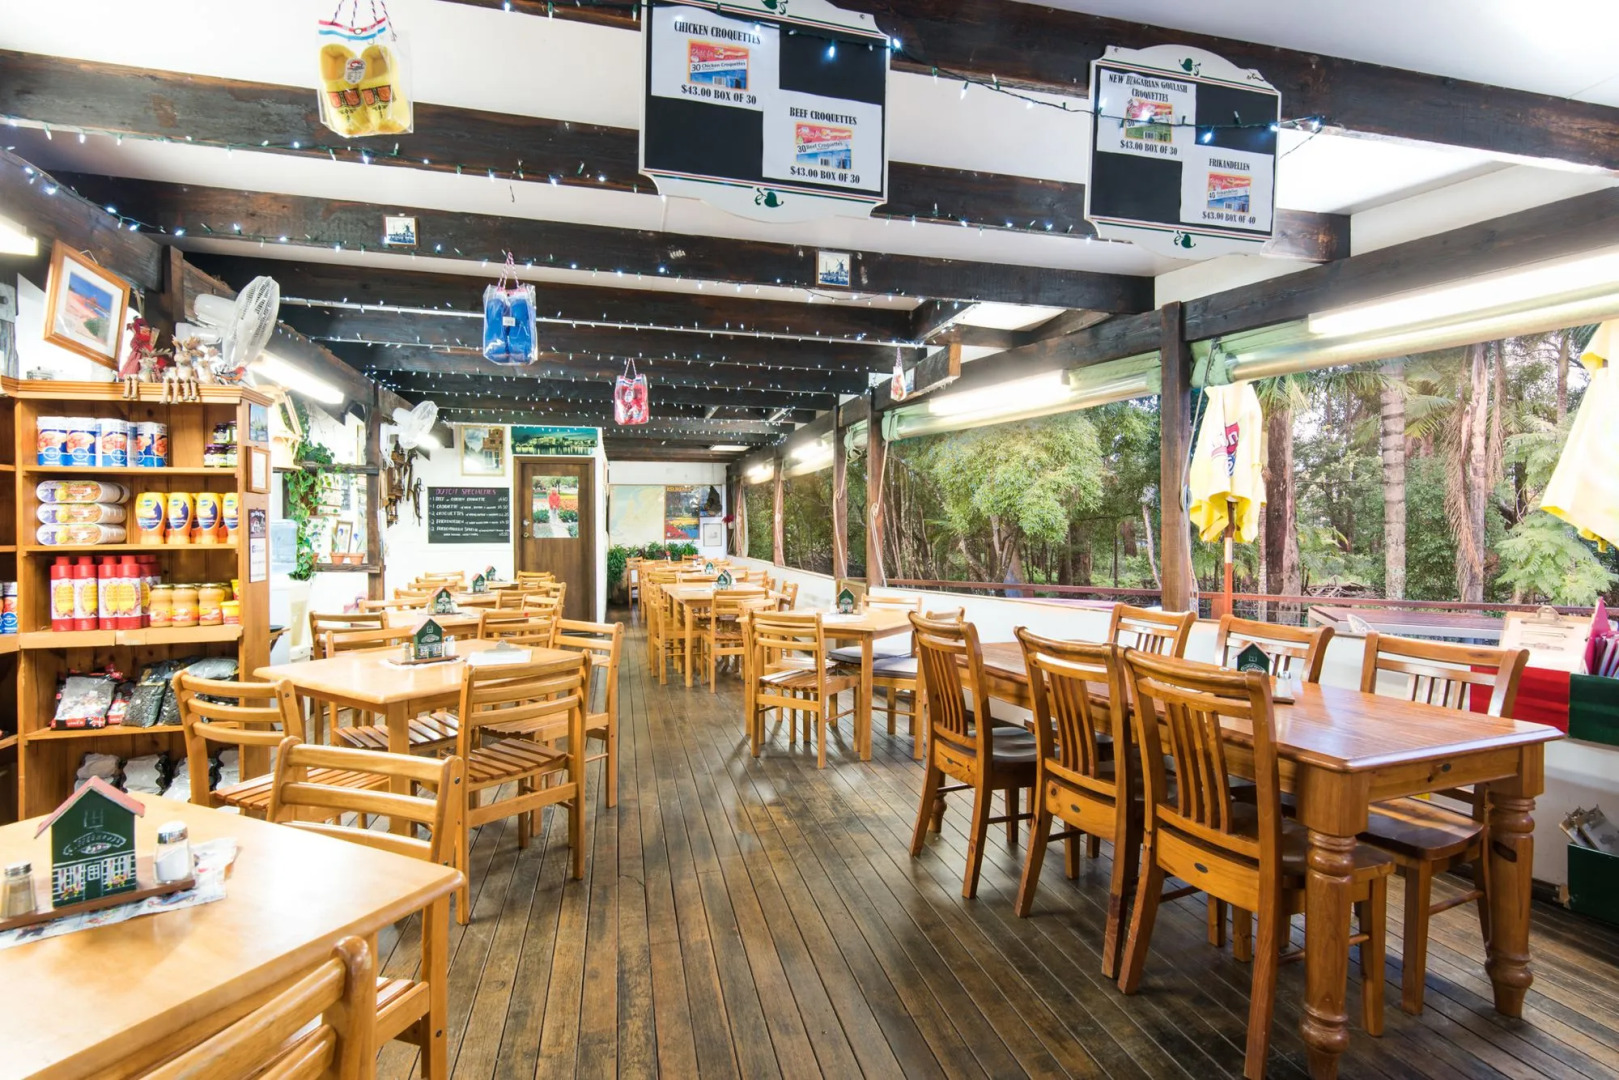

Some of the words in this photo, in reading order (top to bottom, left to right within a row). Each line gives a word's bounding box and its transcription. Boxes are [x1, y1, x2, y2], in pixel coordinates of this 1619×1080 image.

[674, 20, 708, 36] CHICKEN
[710, 26, 760, 44] CROQUETTES
[1109, 74, 1124, 83] NEW
[1161, 82, 1188, 93] GOULASH
[681, 84, 711, 97] $43.00
[714, 90, 731, 101] BOX
[734, 93, 744, 102] OF
[746, 94, 756, 104] 30
[1132, 88, 1168, 102] CROQUETTES
[790, 107, 808, 118] BEEF
[810, 110, 857, 125] CROQUETTES
[1120, 140, 1143, 150] $43.00
[1145, 143, 1158, 153] BOX
[1160, 145, 1168, 154] OF
[1169, 147, 1177, 155] 30
[1209, 158, 1250, 170] FRIKANDELLEN
[790, 166, 818, 178] $43.00
[820, 170, 835, 180] BOX
[838, 173, 848, 182] OF
[850, 174, 860, 184] 30
[1202, 211, 1224, 220] $43.00
[1225, 213, 1237, 222] BOX
[1238, 215, 1246, 223] OF
